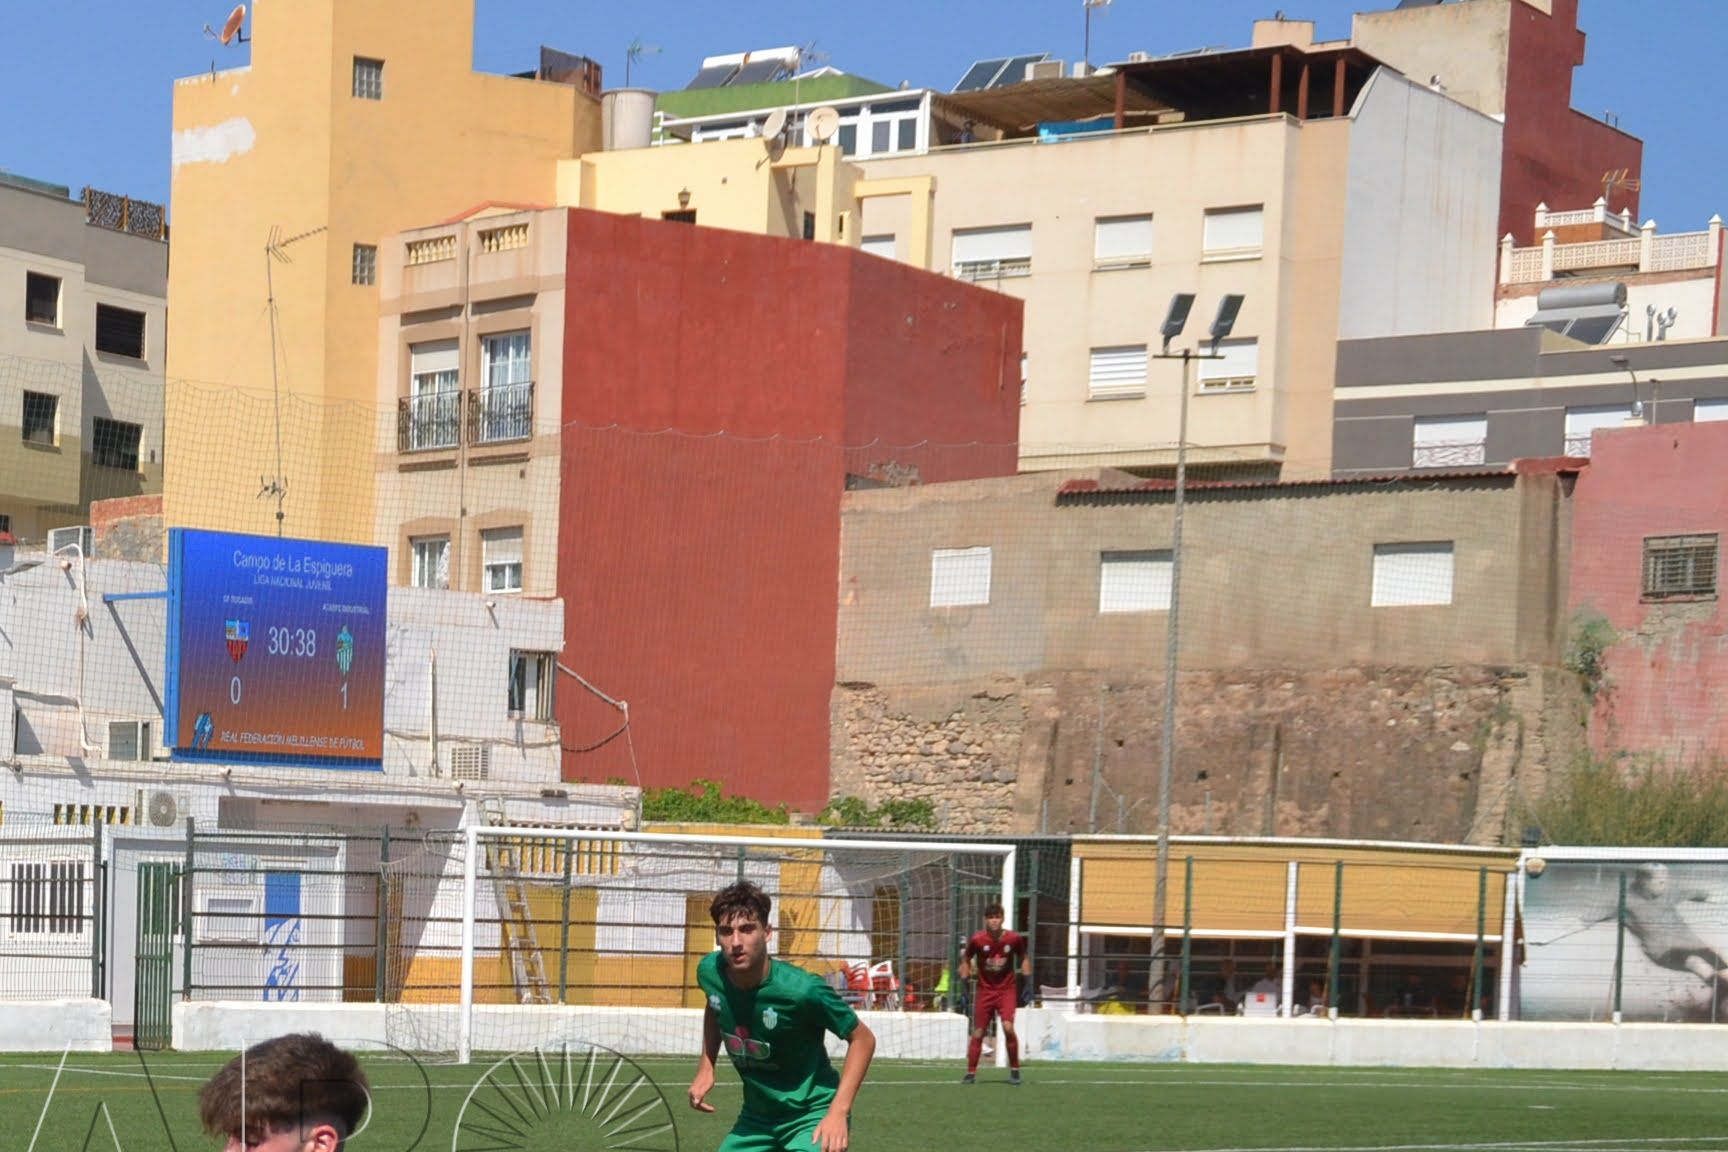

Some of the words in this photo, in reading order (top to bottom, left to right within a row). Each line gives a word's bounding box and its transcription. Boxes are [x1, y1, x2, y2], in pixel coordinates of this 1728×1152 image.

[233, 550, 270, 575] Campo
[273, 553, 285, 571] de
[288, 554, 301, 572] La
[304, 556, 353, 579] Espiguera
[268, 626, 316, 657] 30:38
[230, 676, 242, 705] 0
[340, 683, 349, 709] 1
